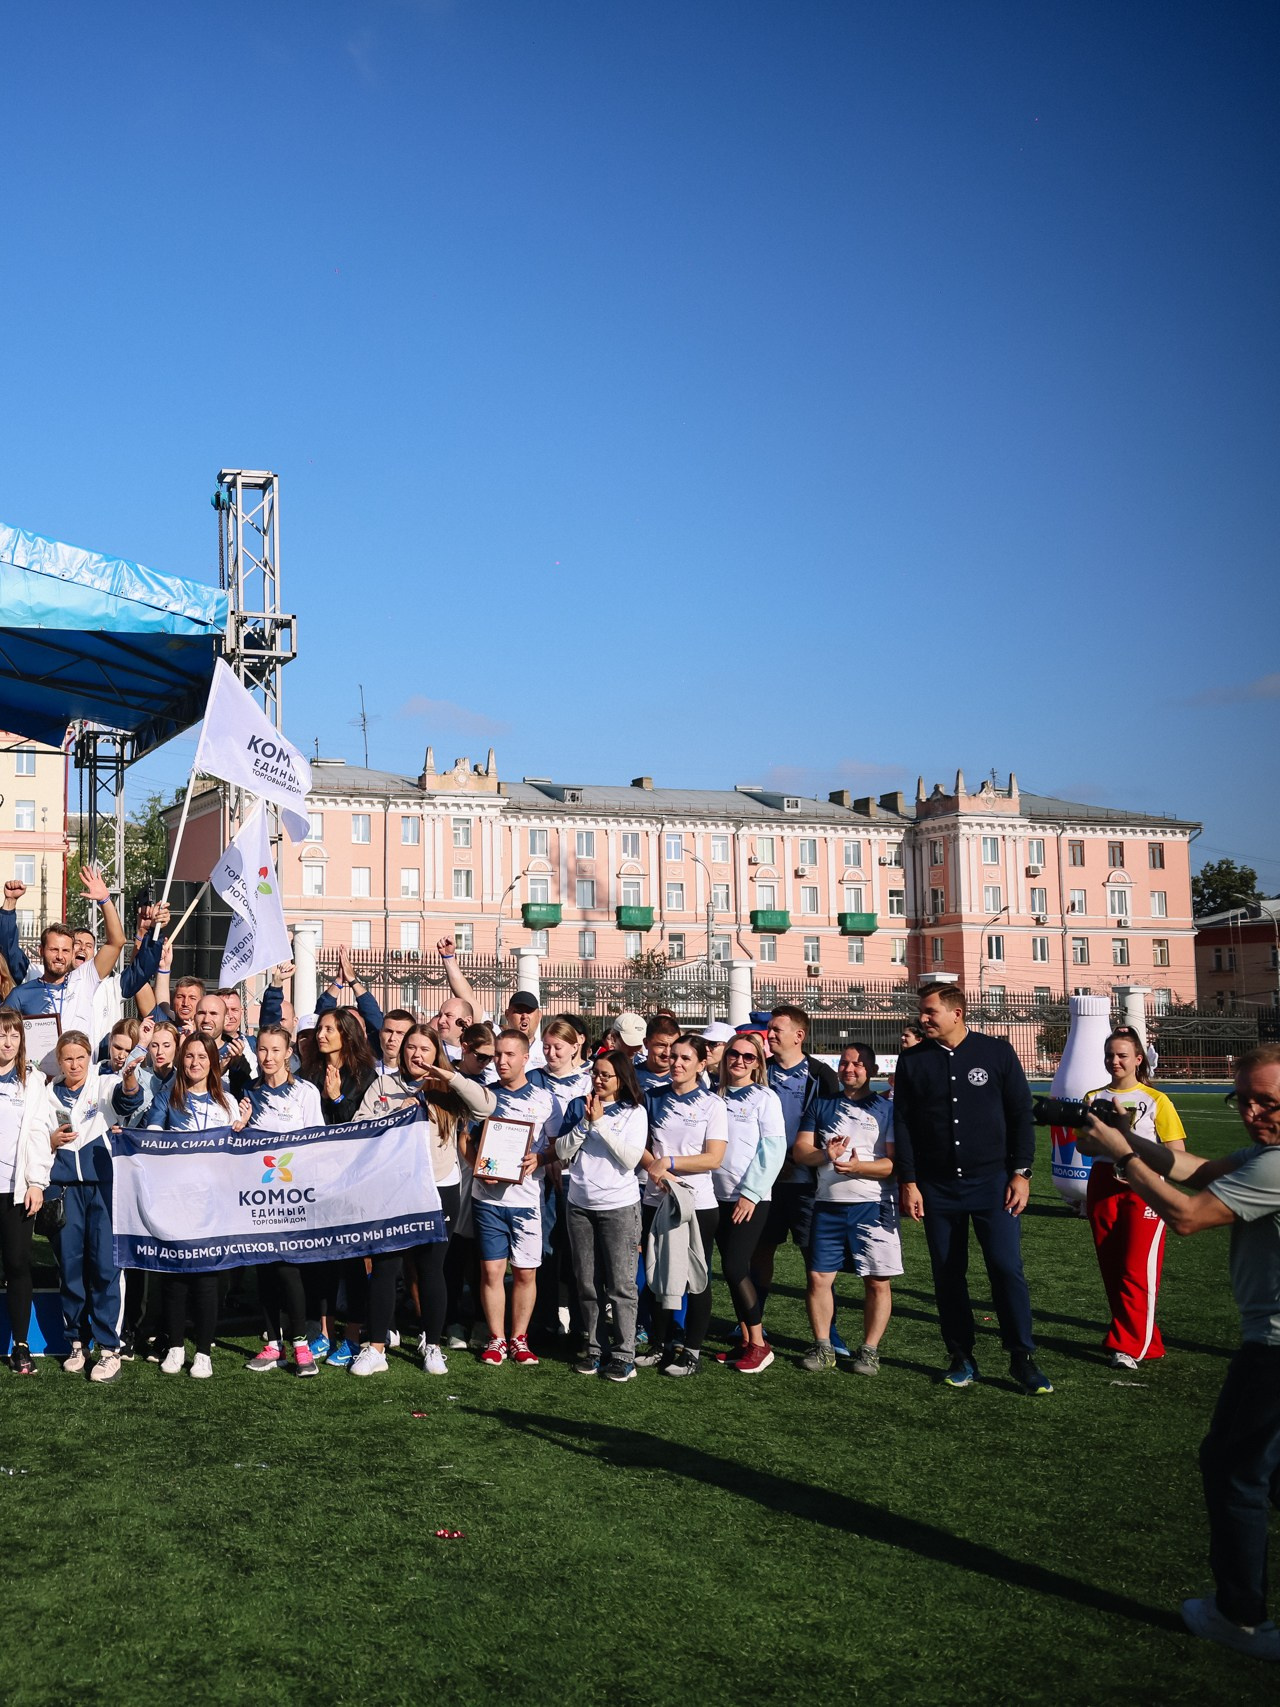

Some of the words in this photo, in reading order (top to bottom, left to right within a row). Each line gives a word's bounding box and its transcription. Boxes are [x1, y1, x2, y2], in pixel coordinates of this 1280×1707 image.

[247, 735, 292, 768] КОМ
[252, 768, 287, 787] ТОРГОВЫЙ
[224, 864, 247, 894] ТОРГО
[141, 1140, 178, 1149] НАША
[181, 1139, 216, 1149] СИЛА
[218, 1138, 225, 1146] В
[227, 1134, 290, 1148] ЕДИНСТВЕ!
[291, 1131, 326, 1142] НАША
[328, 1124, 359, 1136] ВОЛЯ
[360, 1122, 368, 1130] В
[1053, 1166, 1088, 1179] МОЛОКО
[239, 1187, 316, 1207] КОМОС
[251, 1206, 306, 1218] ЕДИНЫЙ
[253, 1217, 289, 1226] ТОРГОВЫЙ
[290, 1216, 307, 1224] ДОМ
[136, 1244, 158, 1256] МЫ
[160, 1246, 222, 1260] ДОБЬЕМСЯ
[223, 1242, 279, 1256] УСПЕХОВ,
[280, 1236, 334, 1251] ПОТОМУ
[335, 1233, 361, 1245] ЧТО
[363, 1229, 384, 1241] МЫ
[386, 1220, 435, 1237] ВМЕСТЕ!
